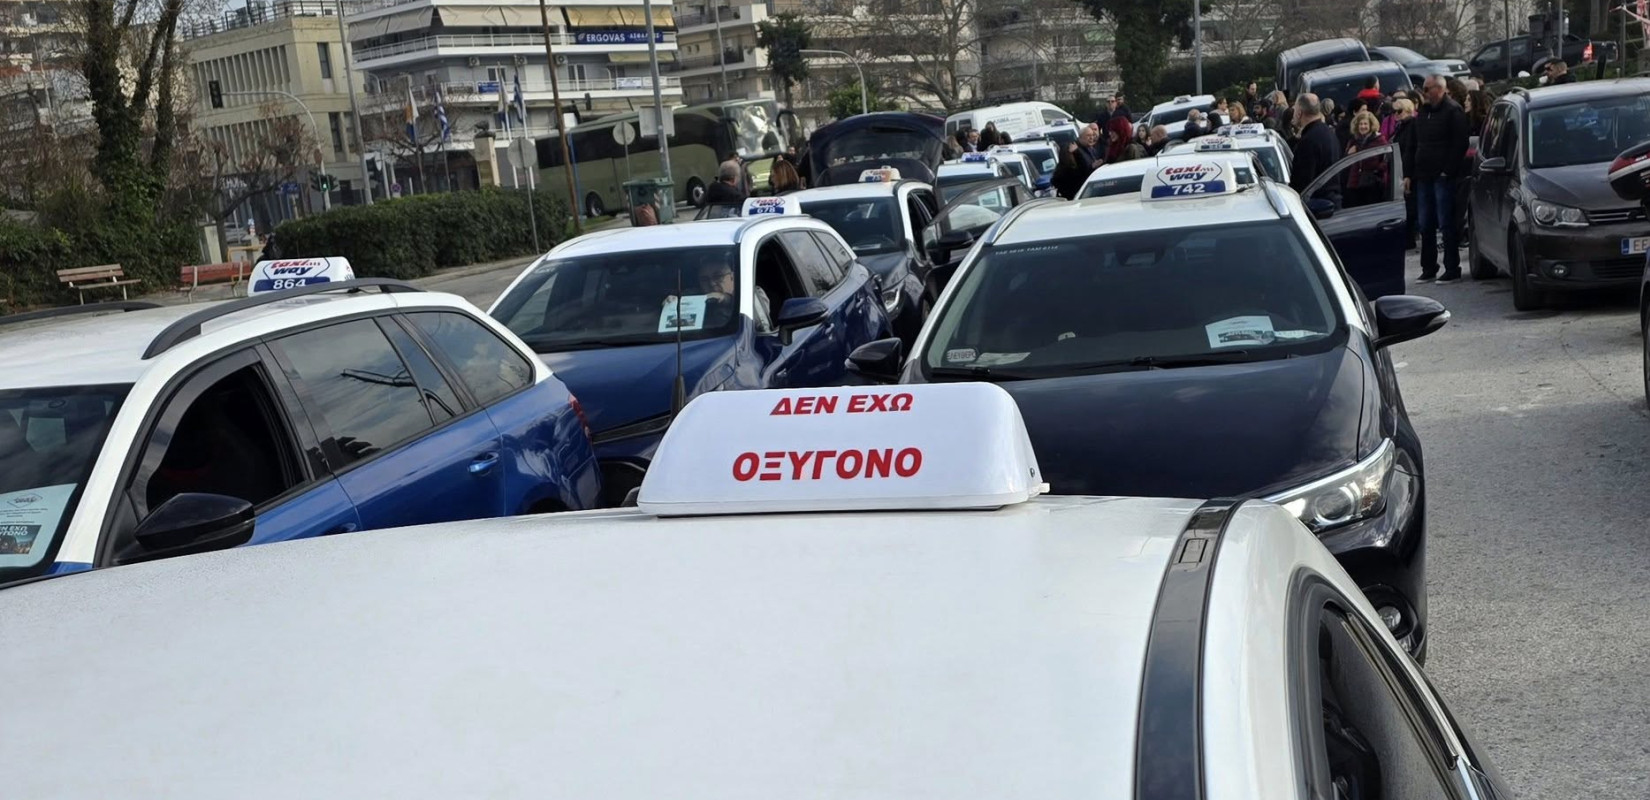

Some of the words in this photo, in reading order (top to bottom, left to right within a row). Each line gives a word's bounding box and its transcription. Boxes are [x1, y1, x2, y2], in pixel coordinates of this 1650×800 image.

[586, 33, 625, 42] ERGOVAS
[1165, 164, 1202, 175] taxi
[1169, 172, 1207, 181] way
[1172, 183, 1206, 195] 742
[271, 259, 309, 269] taxi
[273, 266, 313, 276] way
[273, 279, 307, 290] 864
[769, 395, 839, 416] ΔΕΝ
[846, 393, 914, 413] ΕΧΩ
[732, 447, 922, 482] ΟΞΥΓΟΝΟ
